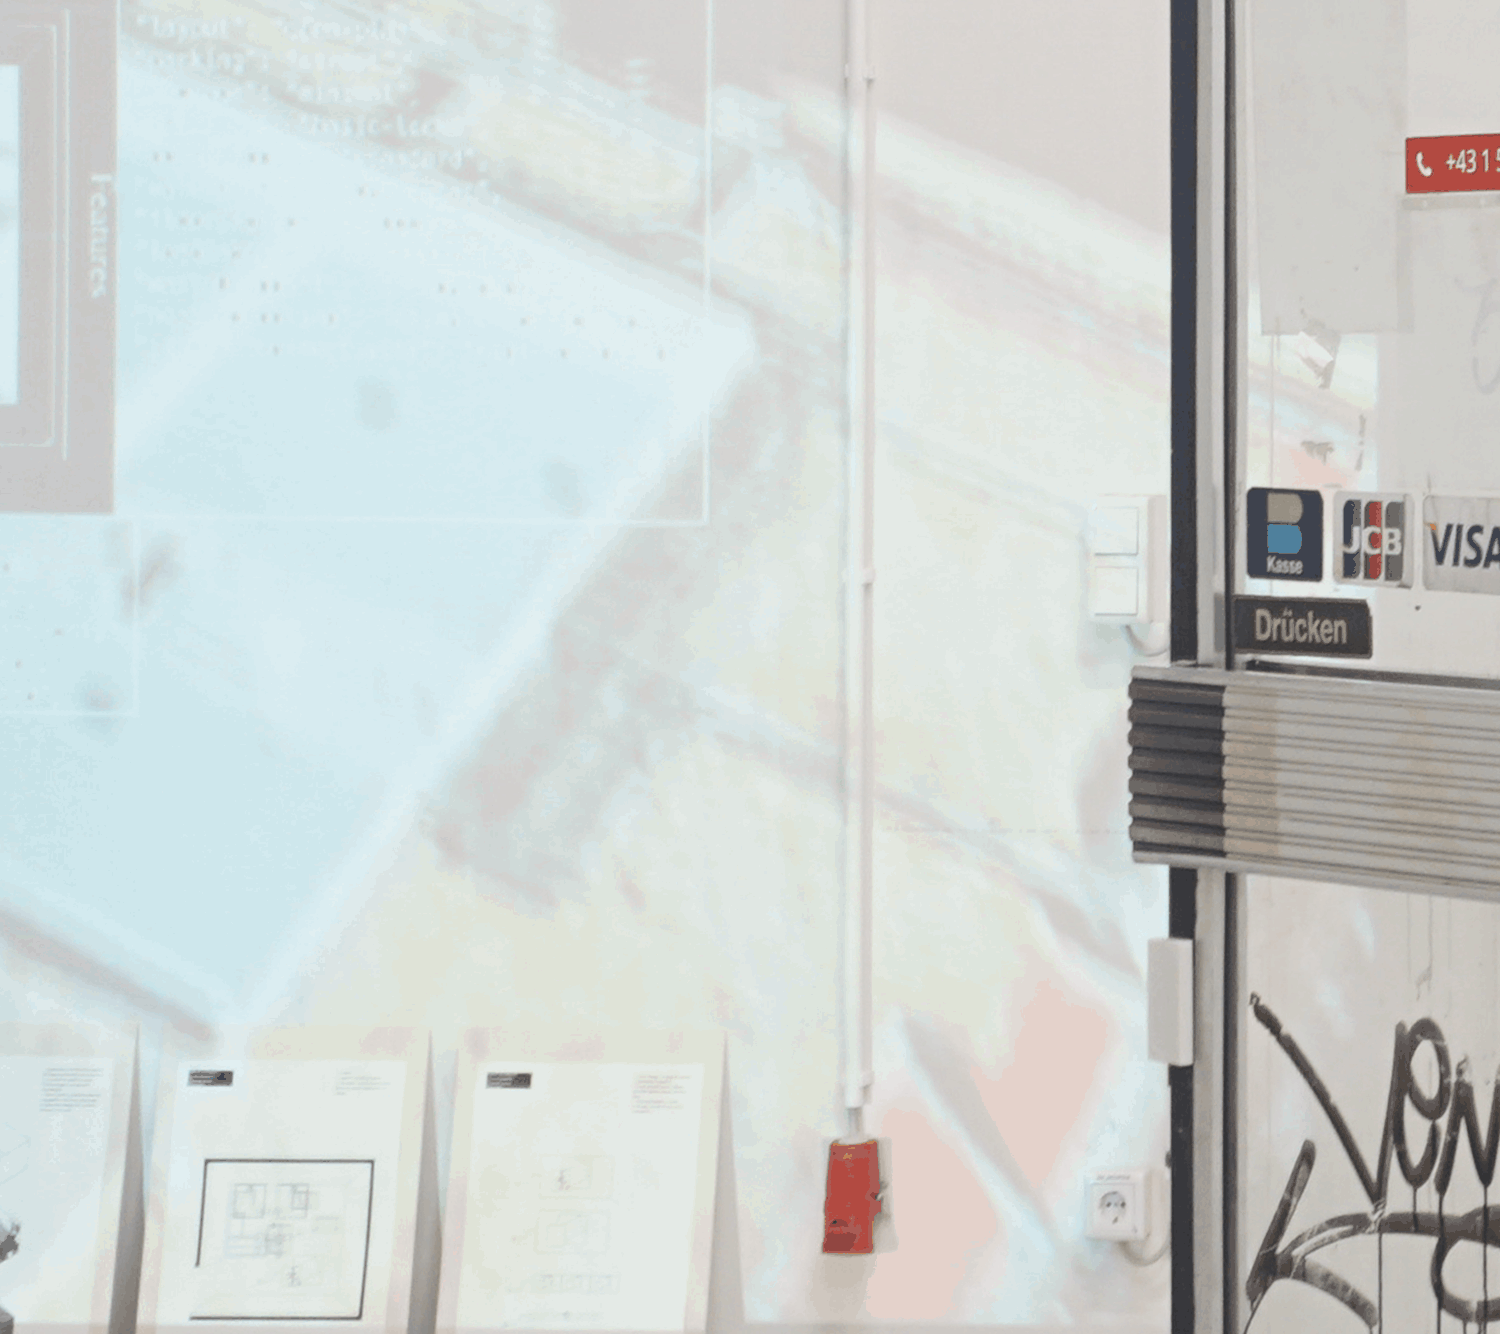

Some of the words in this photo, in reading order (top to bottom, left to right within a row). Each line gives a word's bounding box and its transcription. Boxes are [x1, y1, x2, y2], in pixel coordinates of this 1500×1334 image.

[1446, 148, 1477, 173] +43
[1481, 148, 1489, 172] 1
[1342, 525, 1402, 555] JCB
[1266, 554, 1304, 576] Kasse
[1254, 607, 1348, 645] Drücken
